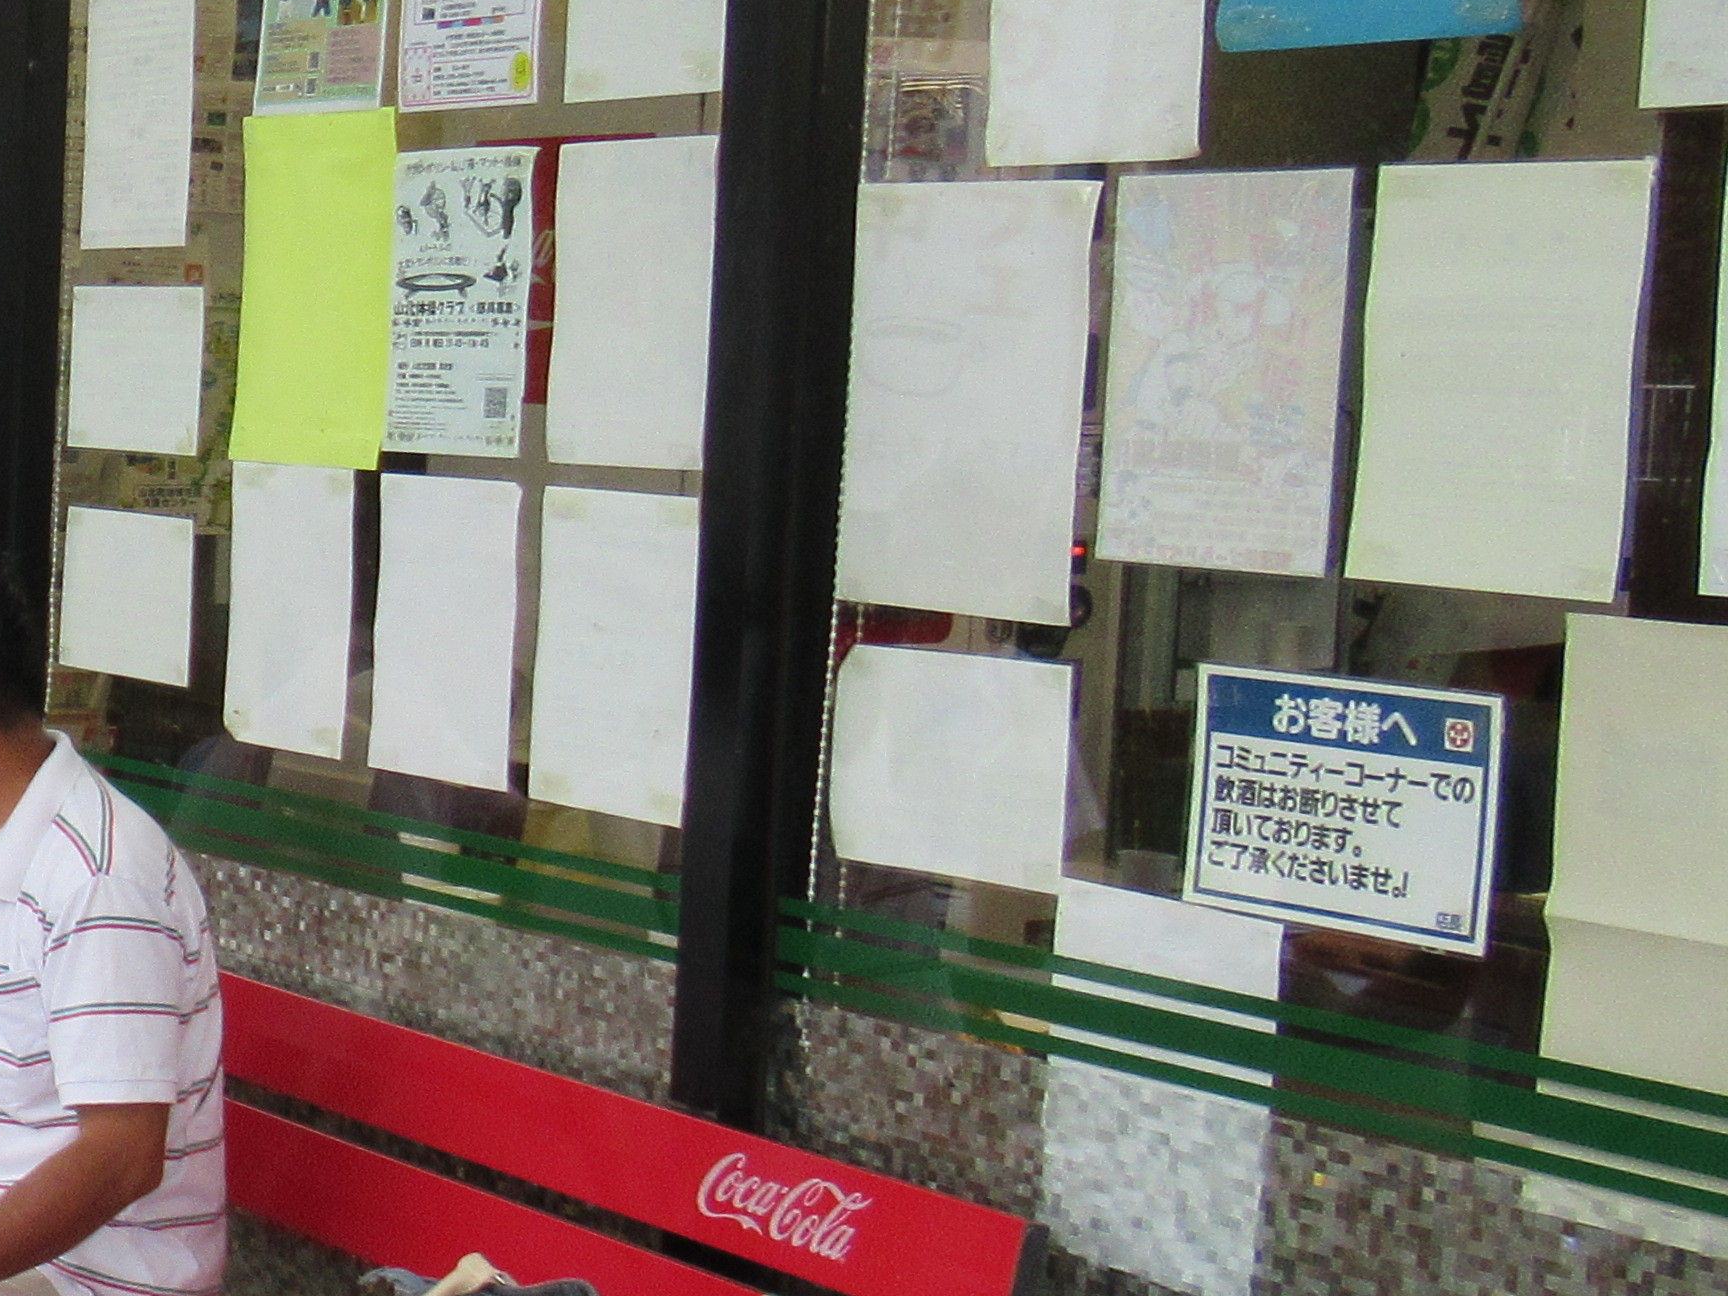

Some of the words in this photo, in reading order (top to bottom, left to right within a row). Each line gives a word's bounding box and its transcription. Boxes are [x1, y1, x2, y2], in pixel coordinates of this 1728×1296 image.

[1272, 693, 1418, 747] お客様へ
[1215, 744, 1476, 804] コミュニティーコーナーでの
[1215, 774, 1404, 829] 飲酒はお断りさせて
[1211, 807, 1363, 858] 頂いております。
[697, 1152, 872, 1261] Coca-Cola
